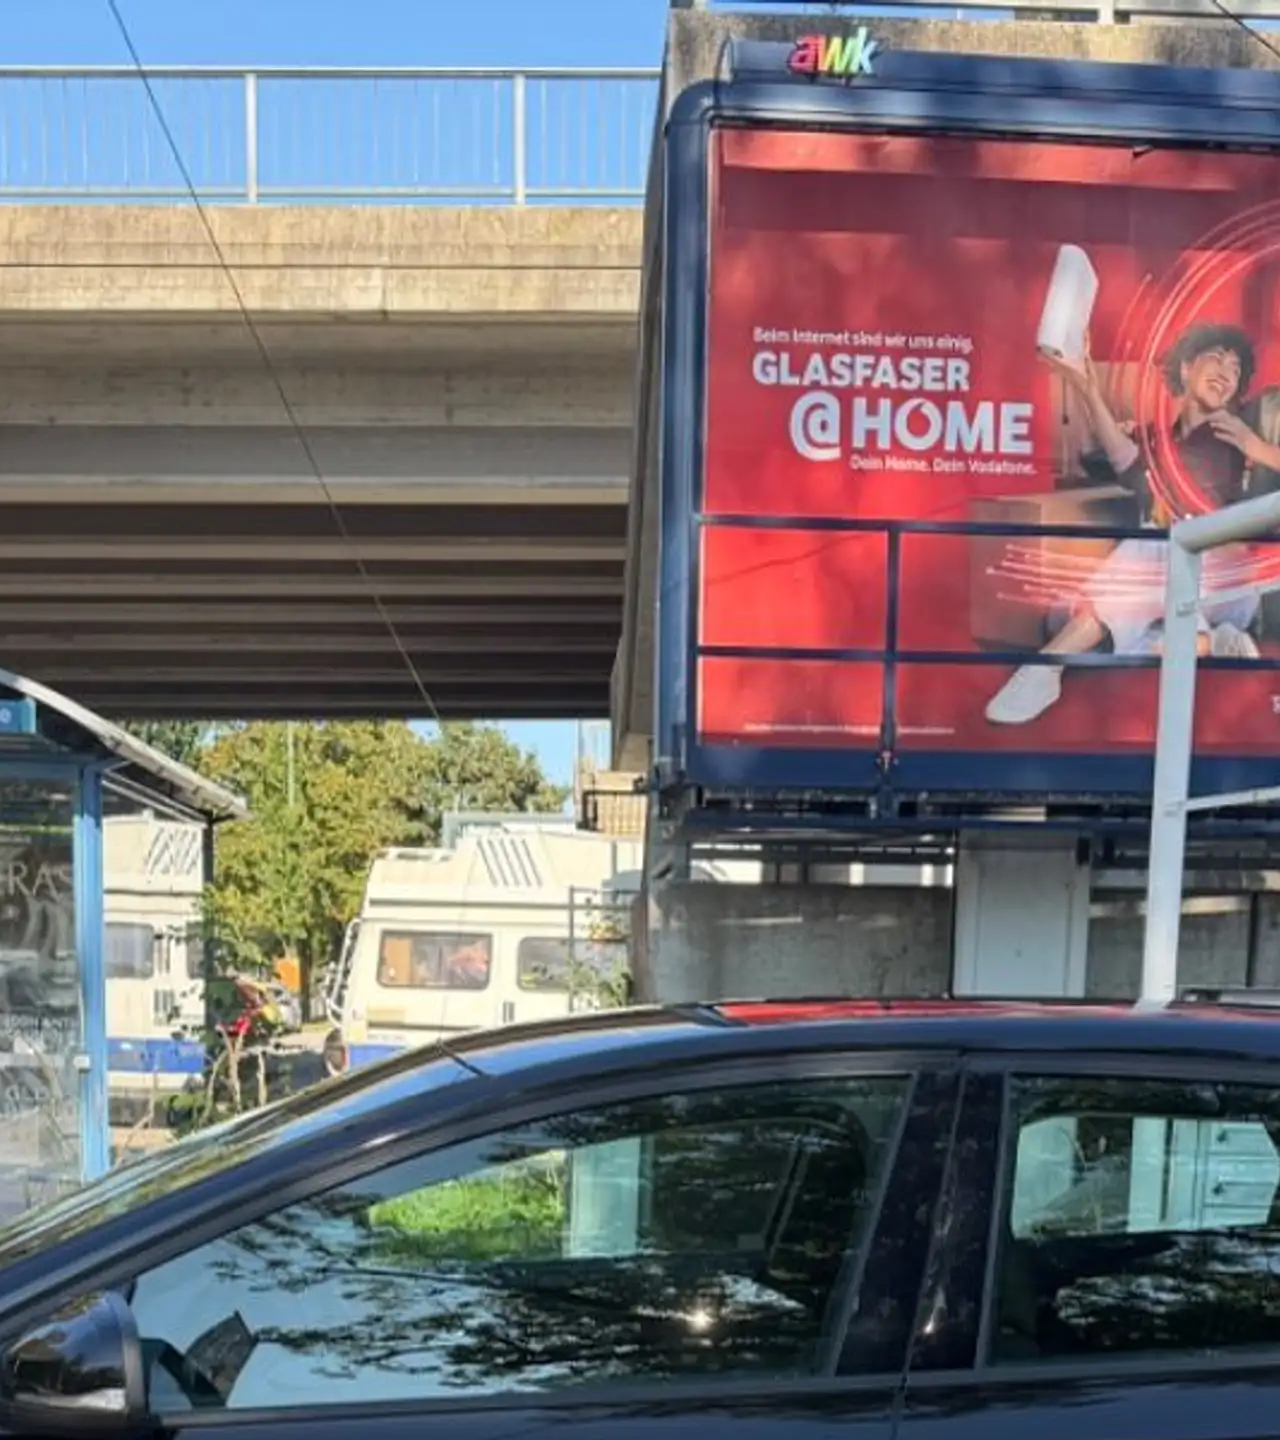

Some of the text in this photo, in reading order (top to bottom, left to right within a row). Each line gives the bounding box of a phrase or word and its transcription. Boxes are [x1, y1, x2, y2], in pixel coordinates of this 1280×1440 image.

[789, 26, 878, 74] awk
[753, 326, 974, 355] Beim Internet sind wir uns einig.
[752, 350, 970, 392] GLASFASER
[789, 389, 1034, 462] @HOME
[850, 454, 1038, 476] Dein Home. Dein Vodafone.
